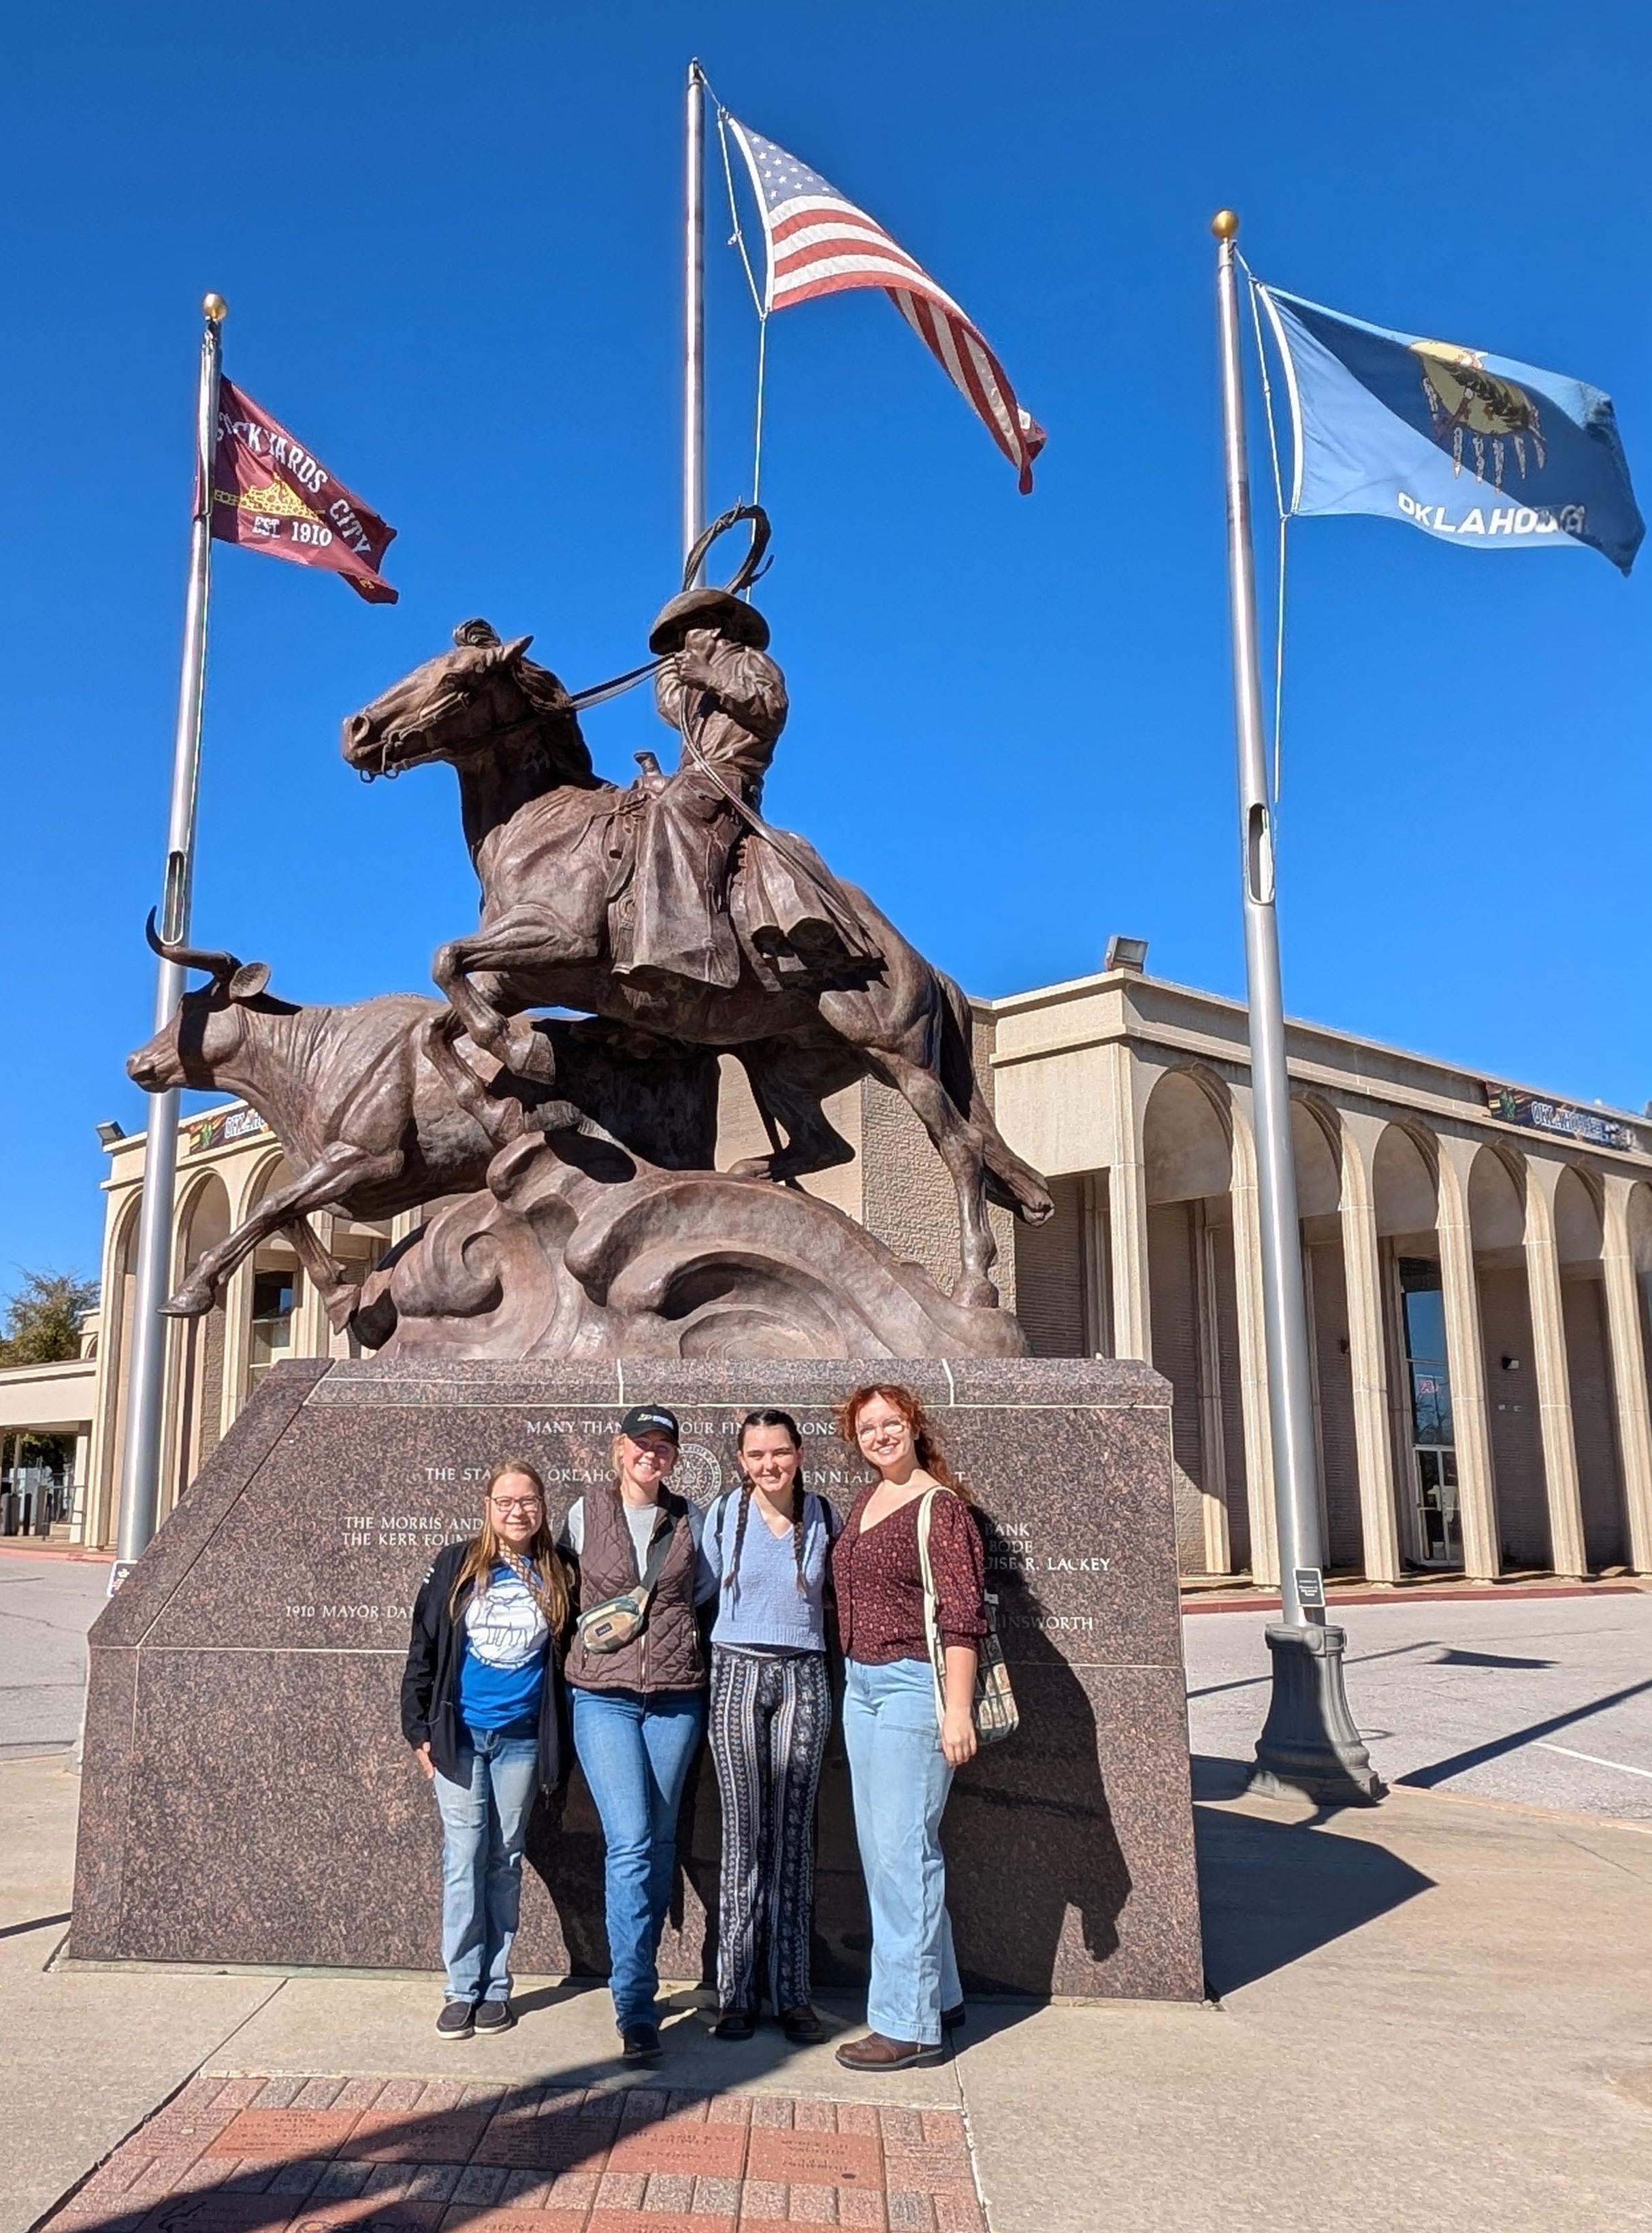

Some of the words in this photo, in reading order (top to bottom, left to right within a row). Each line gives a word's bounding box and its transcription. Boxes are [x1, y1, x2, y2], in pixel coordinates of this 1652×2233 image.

[1397, 491, 1586, 535] OKLAHOA
[253, 516, 280, 538] EST
[291, 521, 332, 547] 1910
[329, 499, 371, 555] CITY
[526, 1420, 574, 1435] MANY
[681, 1422, 714, 1435] OUR
[425, 1467, 456, 1481] THE
[344, 1516, 374, 1530] THE
[380, 1516, 442, 1530] MORRIS
[449, 1518, 484, 1531] AND
[342, 1532, 372, 1546] THE
[378, 1532, 417, 1546] KERR
[1025, 1557, 1040, 1571] R.
[1047, 1557, 1111, 1571] LACKEY
[286, 1605, 315, 1617] 1910
[323, 1605, 379, 1618] MAYOR
[997, 1615, 1093, 1630] INSWORTH
